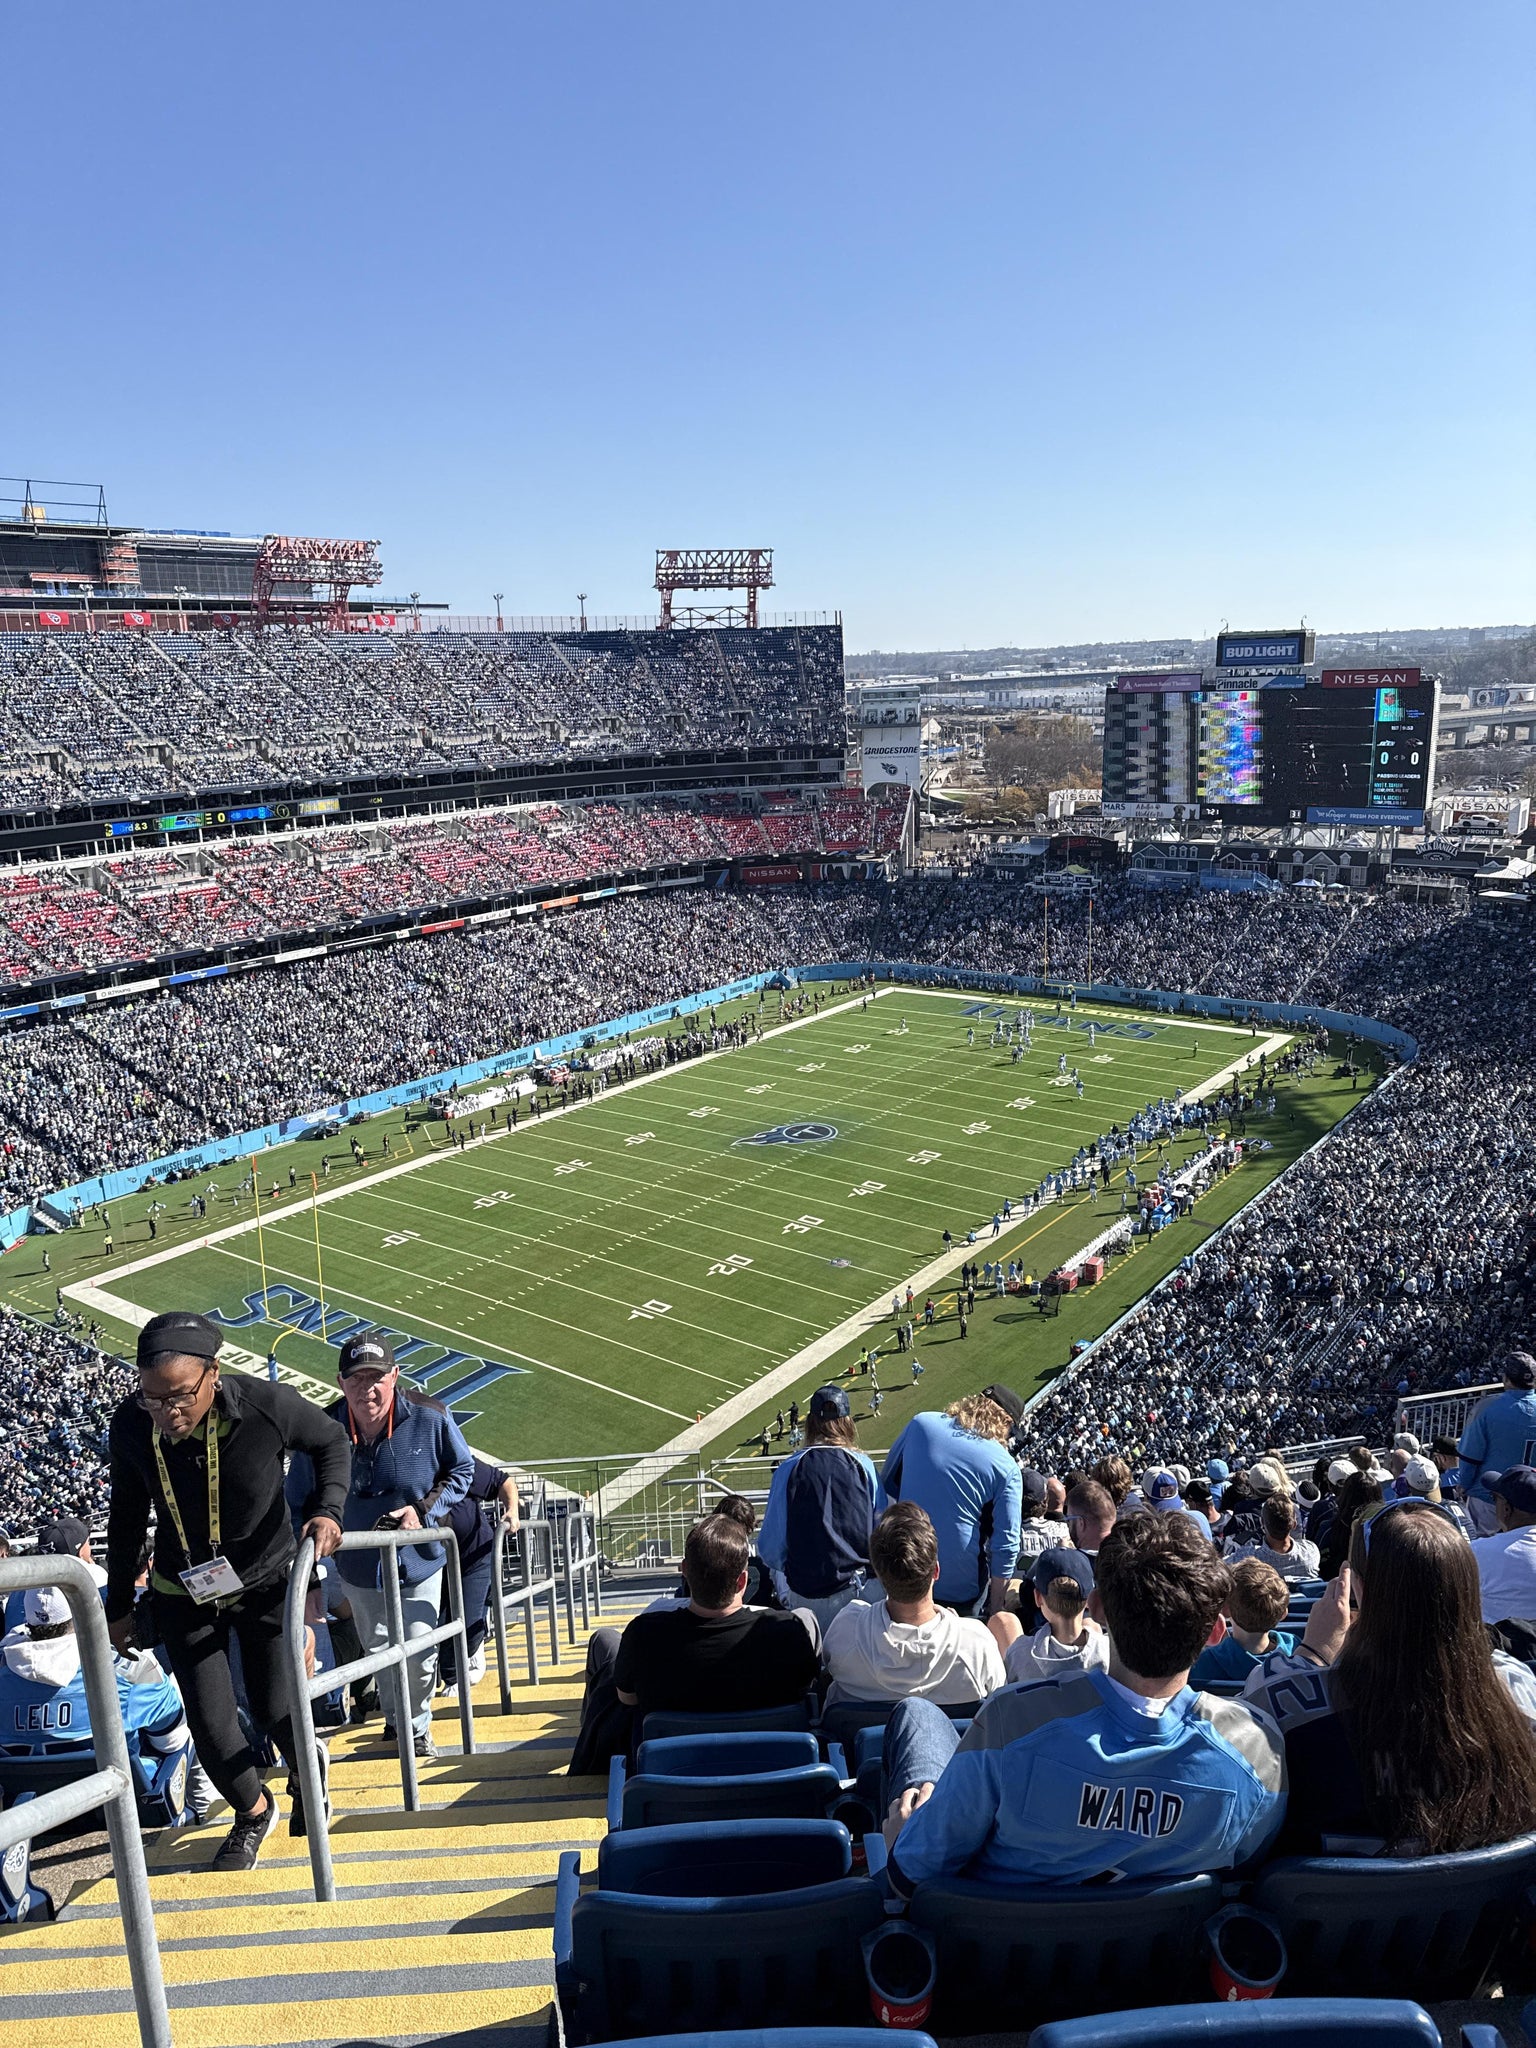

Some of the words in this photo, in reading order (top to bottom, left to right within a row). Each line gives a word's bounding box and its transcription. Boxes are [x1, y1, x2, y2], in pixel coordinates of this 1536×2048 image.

[1226, 647, 1254, 658] BUD
[1255, 645, 1295, 657] LIGHT
[1217, 678, 1258, 690] Pinnacle
[1334, 674, 1407, 684] NISSAN
[864, 746, 919, 755] BRIDGESTONE
[1380, 751, 1389, 764] 0
[1411, 751, 1419, 765] 0
[1444, 802, 1509, 811] NISSAN
[217, 812, 226, 823] 0
[134, 823, 141, 831] &
[141, 822, 148, 830] 3
[1415, 843, 1433, 855] JACK
[749, 868, 791, 878] NISSAN
[1005, 1096, 1037, 1110] 30
[687, 1105, 722, 1118] 50
[962, 1122, 992, 1135] 40
[906, 1149, 942, 1165] 50
[152, 1159, 183, 1176] TENNESSEE
[556, 1158, 593, 1175] 30
[853, 1180, 887, 1197] 40
[477, 1190, 516, 1208] 20
[787, 1214, 825, 1234] 30
[382, 1229, 421, 1246] 10
[711, 1253, 754, 1276] 20
[632, 1299, 673, 1320] 10
[219, 1350, 254, 1366] OF
[14, 1701, 73, 1731] LELO
[1077, 1782, 1185, 1838] WARD
